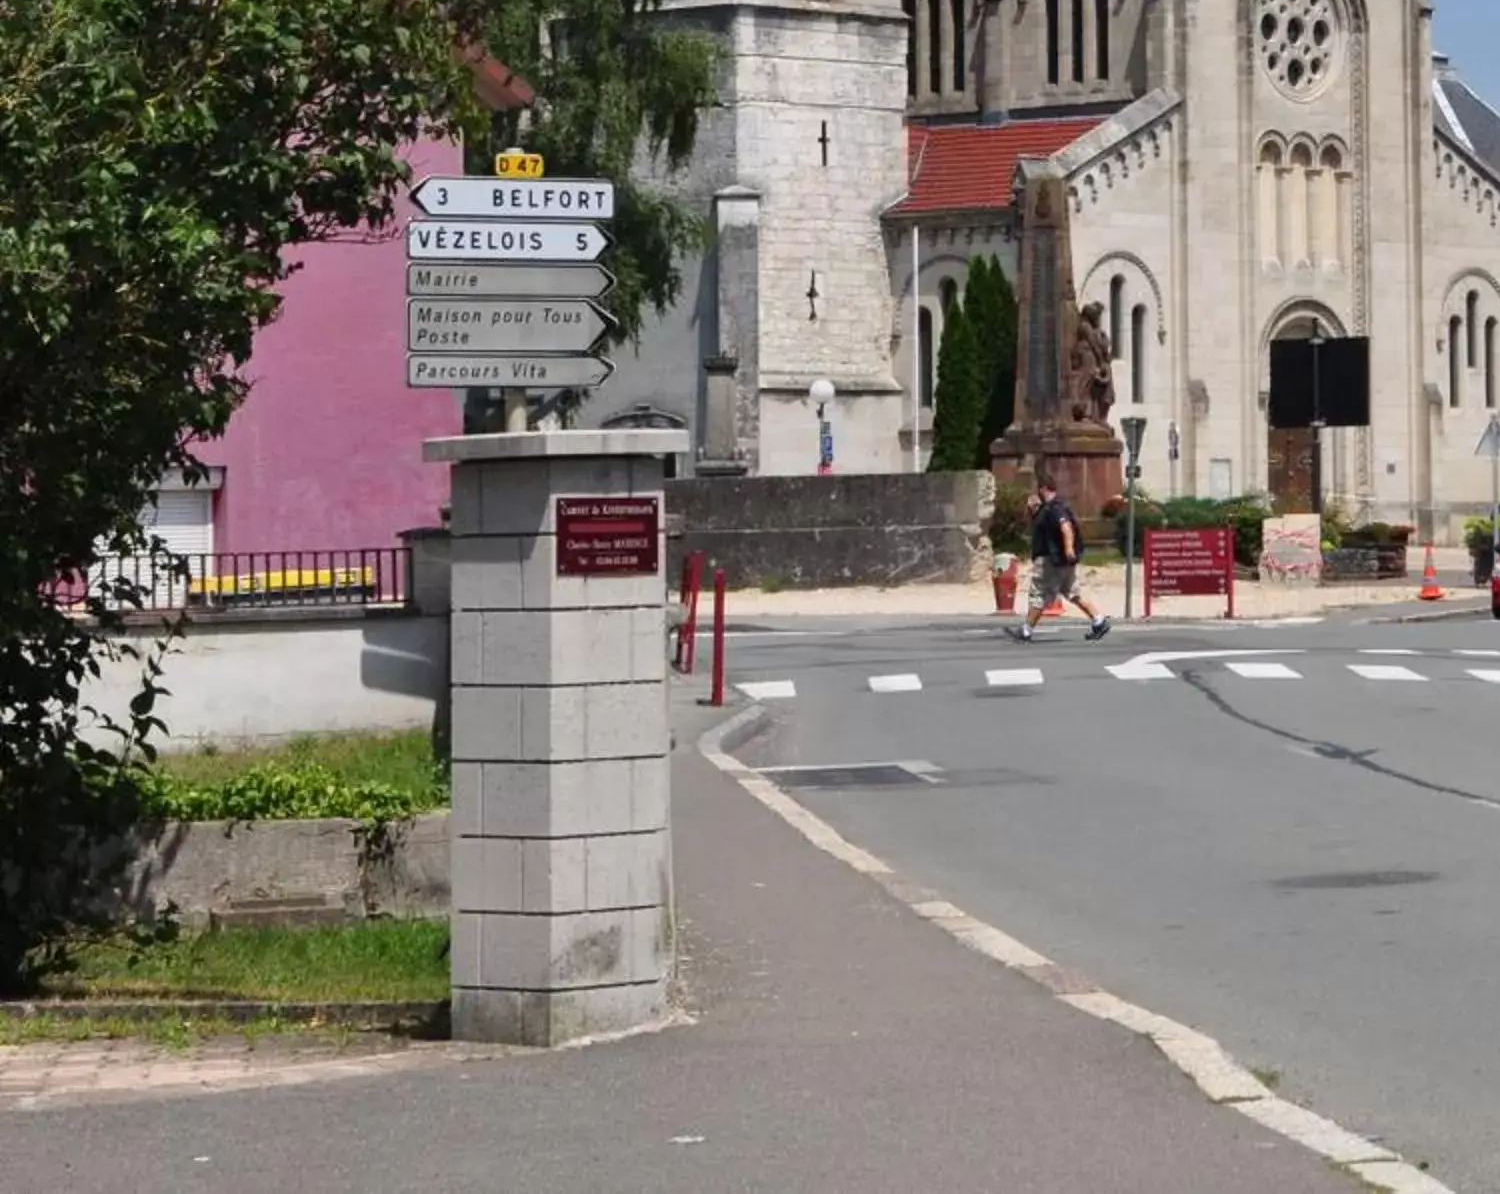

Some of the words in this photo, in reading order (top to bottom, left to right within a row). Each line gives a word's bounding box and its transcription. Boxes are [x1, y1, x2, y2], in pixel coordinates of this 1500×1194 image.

[499, 157, 510, 173] D
[516, 158, 541, 174] 47
[436, 188, 449, 206] 3
[492, 189, 606, 209] BELFORT
[417, 225, 544, 251] VÉZELOIS
[576, 232, 589, 252] 5
[415, 270, 479, 288] Mairie
[416, 307, 482, 323] Maison
[491, 309, 533, 326] pour
[543, 307, 583, 324] Tous
[416, 328, 470, 344] Poste
[415, 362, 500, 379] Parcours
[510, 362, 548, 379] Vita
